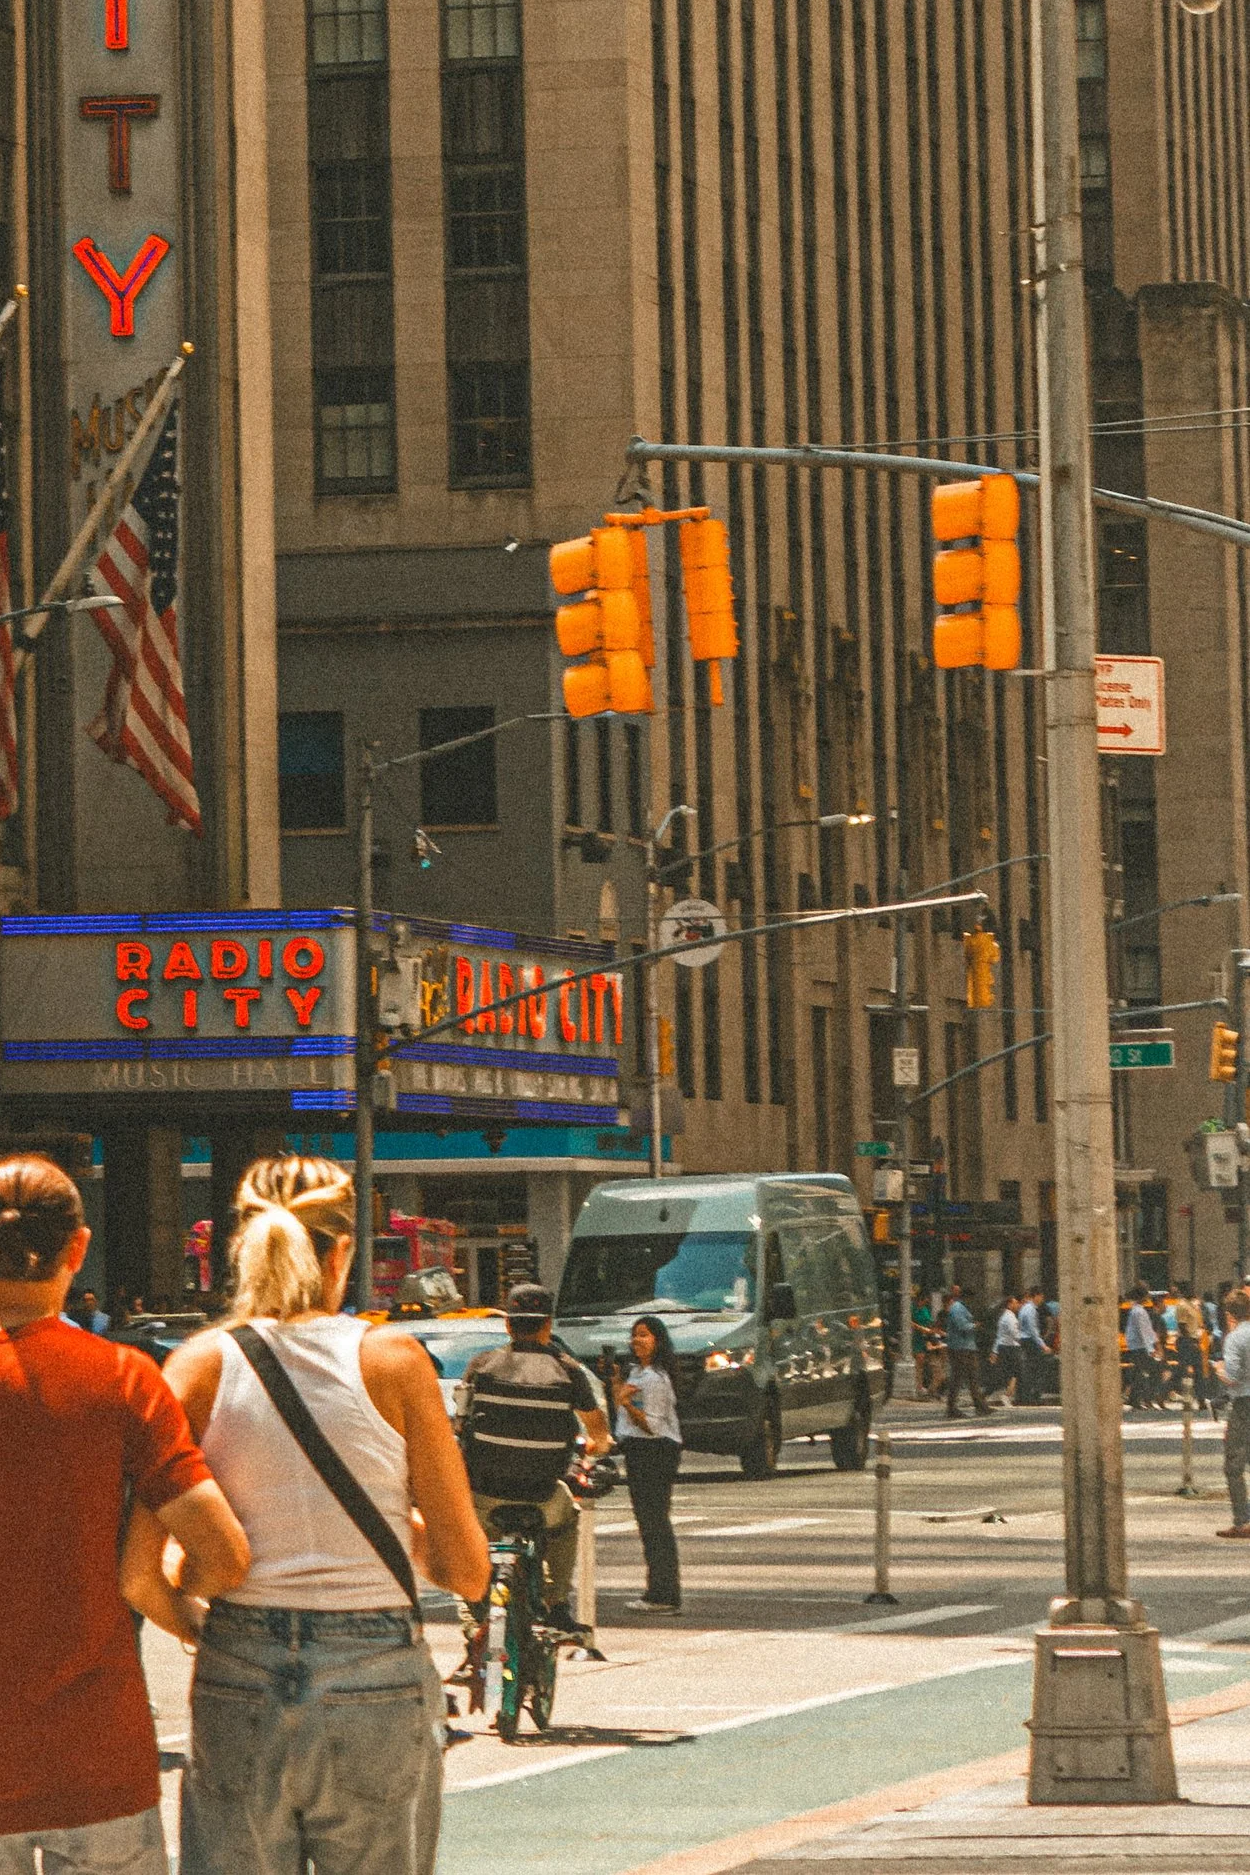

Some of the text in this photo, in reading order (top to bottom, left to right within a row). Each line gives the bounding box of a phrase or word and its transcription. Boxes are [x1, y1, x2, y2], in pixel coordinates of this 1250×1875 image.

[1095, 682, 1132, 694] icense
[116, 936, 325, 981] RADIO
[116, 986, 322, 1030] CITY
[456, 956, 547, 1040] RADIO
[559, 968, 624, 1045] CITY
[94, 1058, 328, 1088] MUSIC HALL
